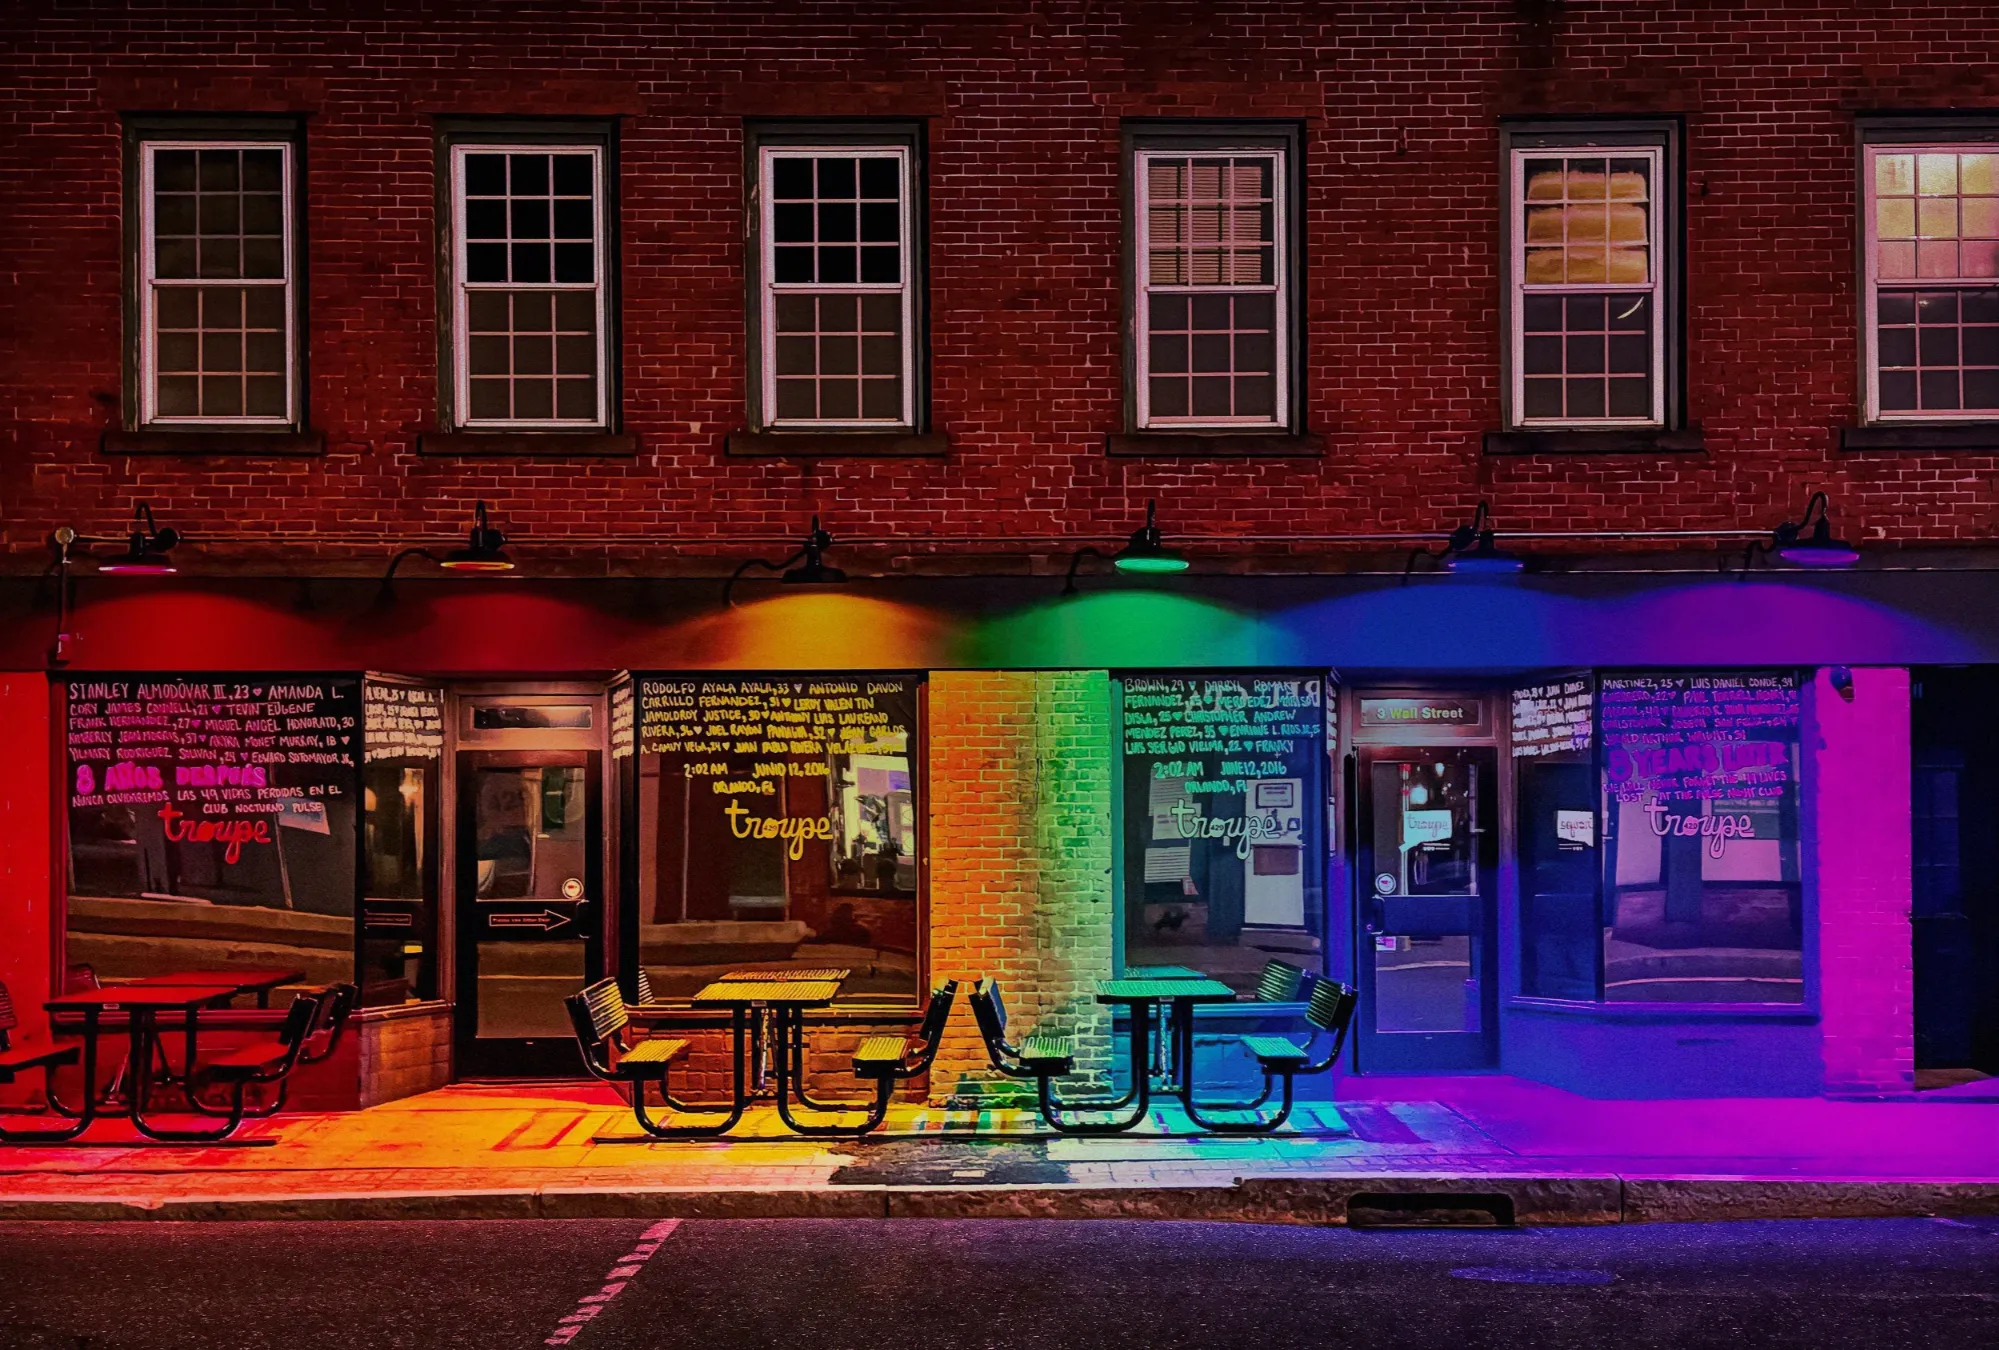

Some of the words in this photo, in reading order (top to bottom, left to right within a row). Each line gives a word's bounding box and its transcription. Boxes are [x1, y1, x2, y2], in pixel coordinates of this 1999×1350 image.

[643, 682, 696, 695] RODOLFO
[702, 682, 736, 695] AYALA
[809, 683, 858, 695] ANTONIO
[867, 682, 903, 695] DAVON
[1691, 677, 1711, 689] LUIS
[1712, 678, 1745, 689] DANIEL
[69, 682, 129, 700] STANLEY
[268, 685, 324, 700] AMANDA
[331, 686, 344, 699] L.
[70, 703, 98, 716] CORY
[105, 703, 142, 714] JAMES
[226, 704, 260, 716] TEVIN
[267, 703, 316, 716] EUGENE
[642, 695, 694, 709] CARRILLO
[1253, 708, 1296, 723] ANDREW
[1376, 707, 1386, 719] 3
[1391, 707, 1418, 719] Wall
[1421, 706, 1463, 719] Street
[69, 718, 107, 730] FRANK
[205, 719, 242, 731] MIGUEL
[245, 719, 281, 733] ANGEL
[1125, 726, 1168, 739] MENDEZ
[1255, 739, 1294, 753] FRANKY
[1631, 743, 1719, 778] YEARS
[752, 762, 787, 779] JUNIO
[1716, 773, 1738, 785] THE
[1759, 770, 1787, 783] LIVES
[76, 764, 96, 796] 8
[761, 781, 776, 794] FL
[1236, 780, 1249, 793] FL
[72, 795, 104, 807] NUNCA
[177, 789, 197, 801] LAS
[201, 790, 218, 801] 49
[221, 788, 252, 800] VIDAS
[257, 786, 304, 799] PERDIDAS
[309, 784, 324, 795] EN
[328, 784, 342, 794] EL
[1616, 790, 1643, 802] LOST
[1658, 790, 1671, 801] AT
[1674, 788, 1694, 800] THE
[1758, 785, 1783, 797] CLUB
[203, 803, 229, 814] CLUB
[235, 803, 285, 813] NOCTURNO
[292, 802, 323, 813] PULSE
[157, 802, 271, 864] troupe
[724, 799, 834, 861] troupe
[1171, 798, 1281, 860] troupe
[1643, 796, 1754, 859] troupe
